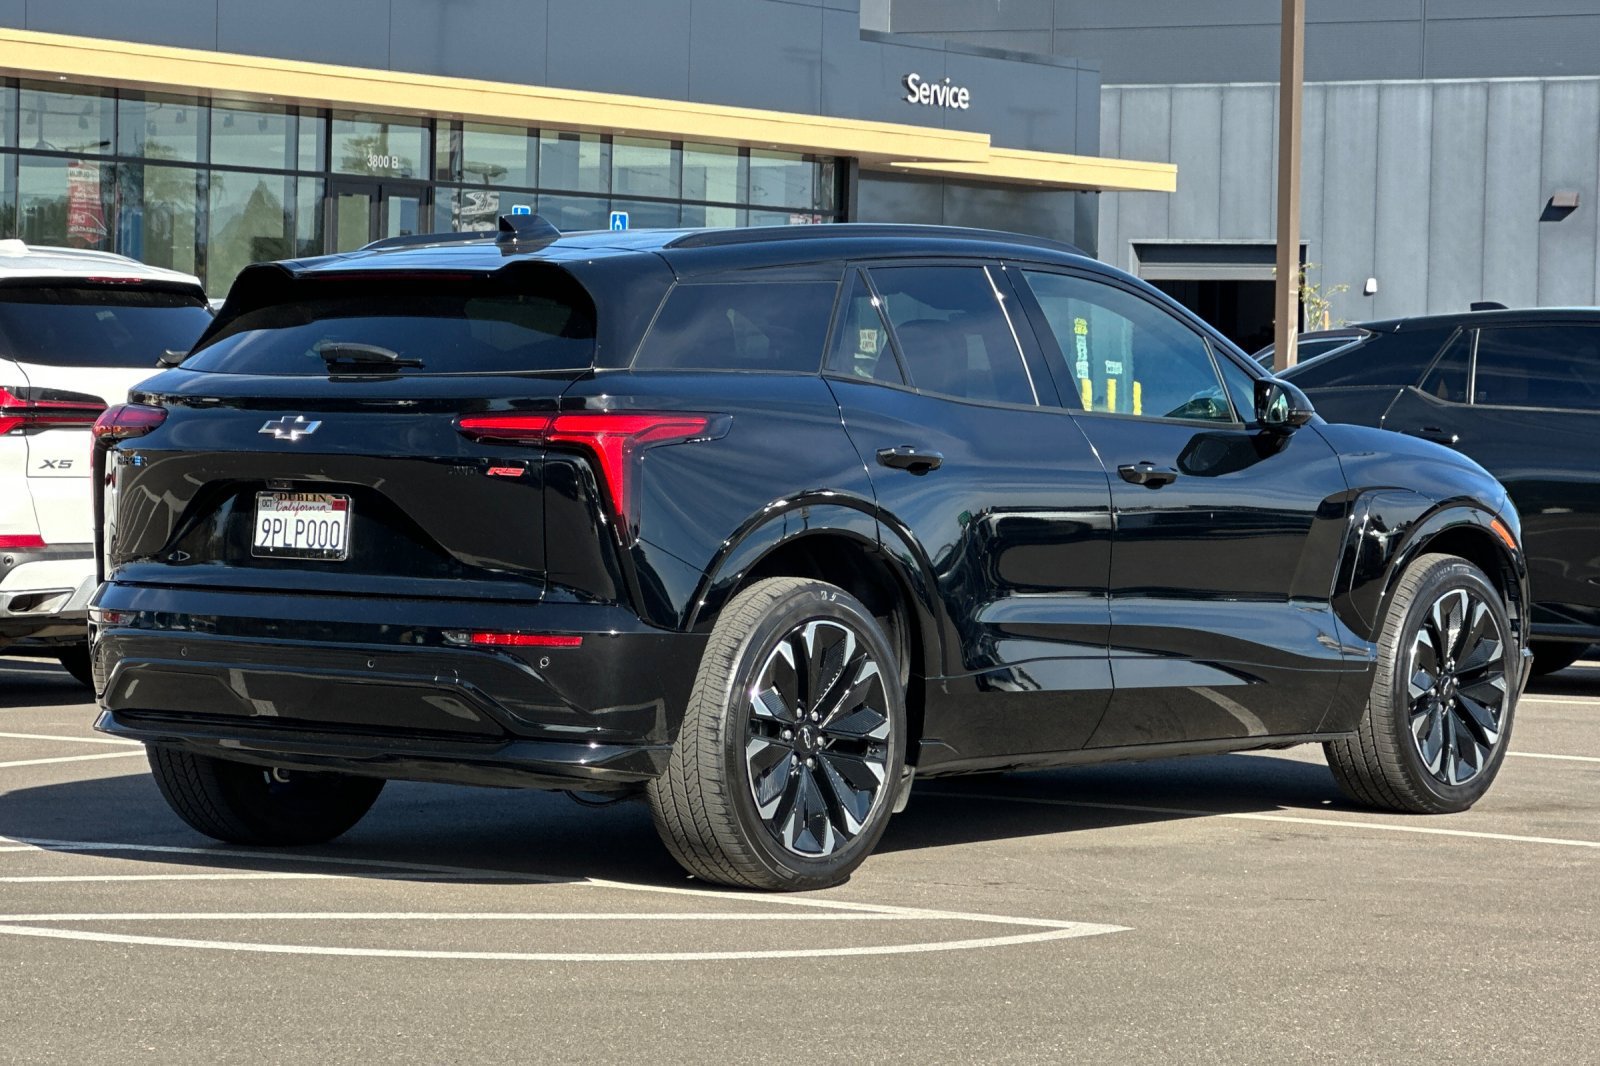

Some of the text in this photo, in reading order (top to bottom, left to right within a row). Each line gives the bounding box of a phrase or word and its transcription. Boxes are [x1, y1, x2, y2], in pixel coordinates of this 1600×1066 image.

[907, 73, 970, 110] Service
[367, 154, 399, 169] 3800 B
[38, 459, 74, 469] X5
[487, 466, 525, 477] RS
[261, 499, 273, 508] OCT
[279, 492, 326, 502] DUBLIN
[275, 501, 330, 516] California
[261, 518, 340, 548] 9PLP000
